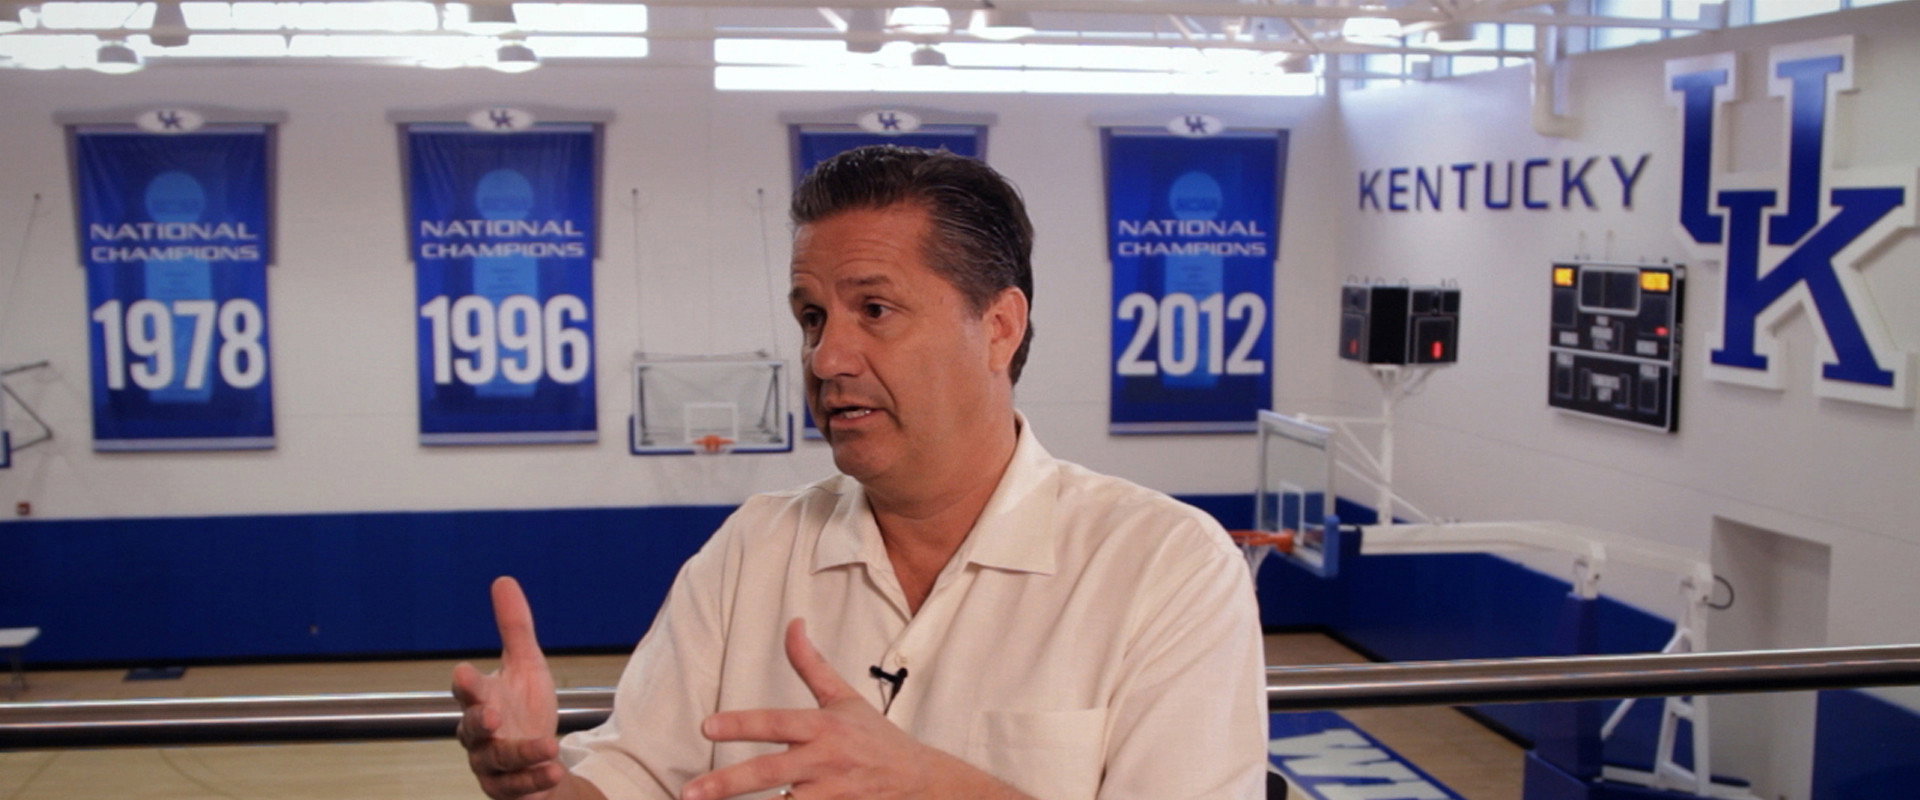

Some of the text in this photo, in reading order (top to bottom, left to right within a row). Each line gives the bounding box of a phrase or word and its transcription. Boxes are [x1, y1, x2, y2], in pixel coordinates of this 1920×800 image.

[1358, 153, 1651, 212] KENTUCKY
[420, 219, 584, 238] NATIONAL
[1118, 219, 1267, 237] NATIONAL
[1671, 54, 1906, 388] UK
[90, 222, 258, 241] NATIONAL
[91, 245, 260, 263] CHAMPIONS
[421, 241, 586, 259] CHAMPIONS
[1118, 241, 1267, 258] CHAMPIONS
[420, 294, 590, 386] 1996
[1116, 292, 1267, 376] 2012
[92, 298, 266, 391] 1978
